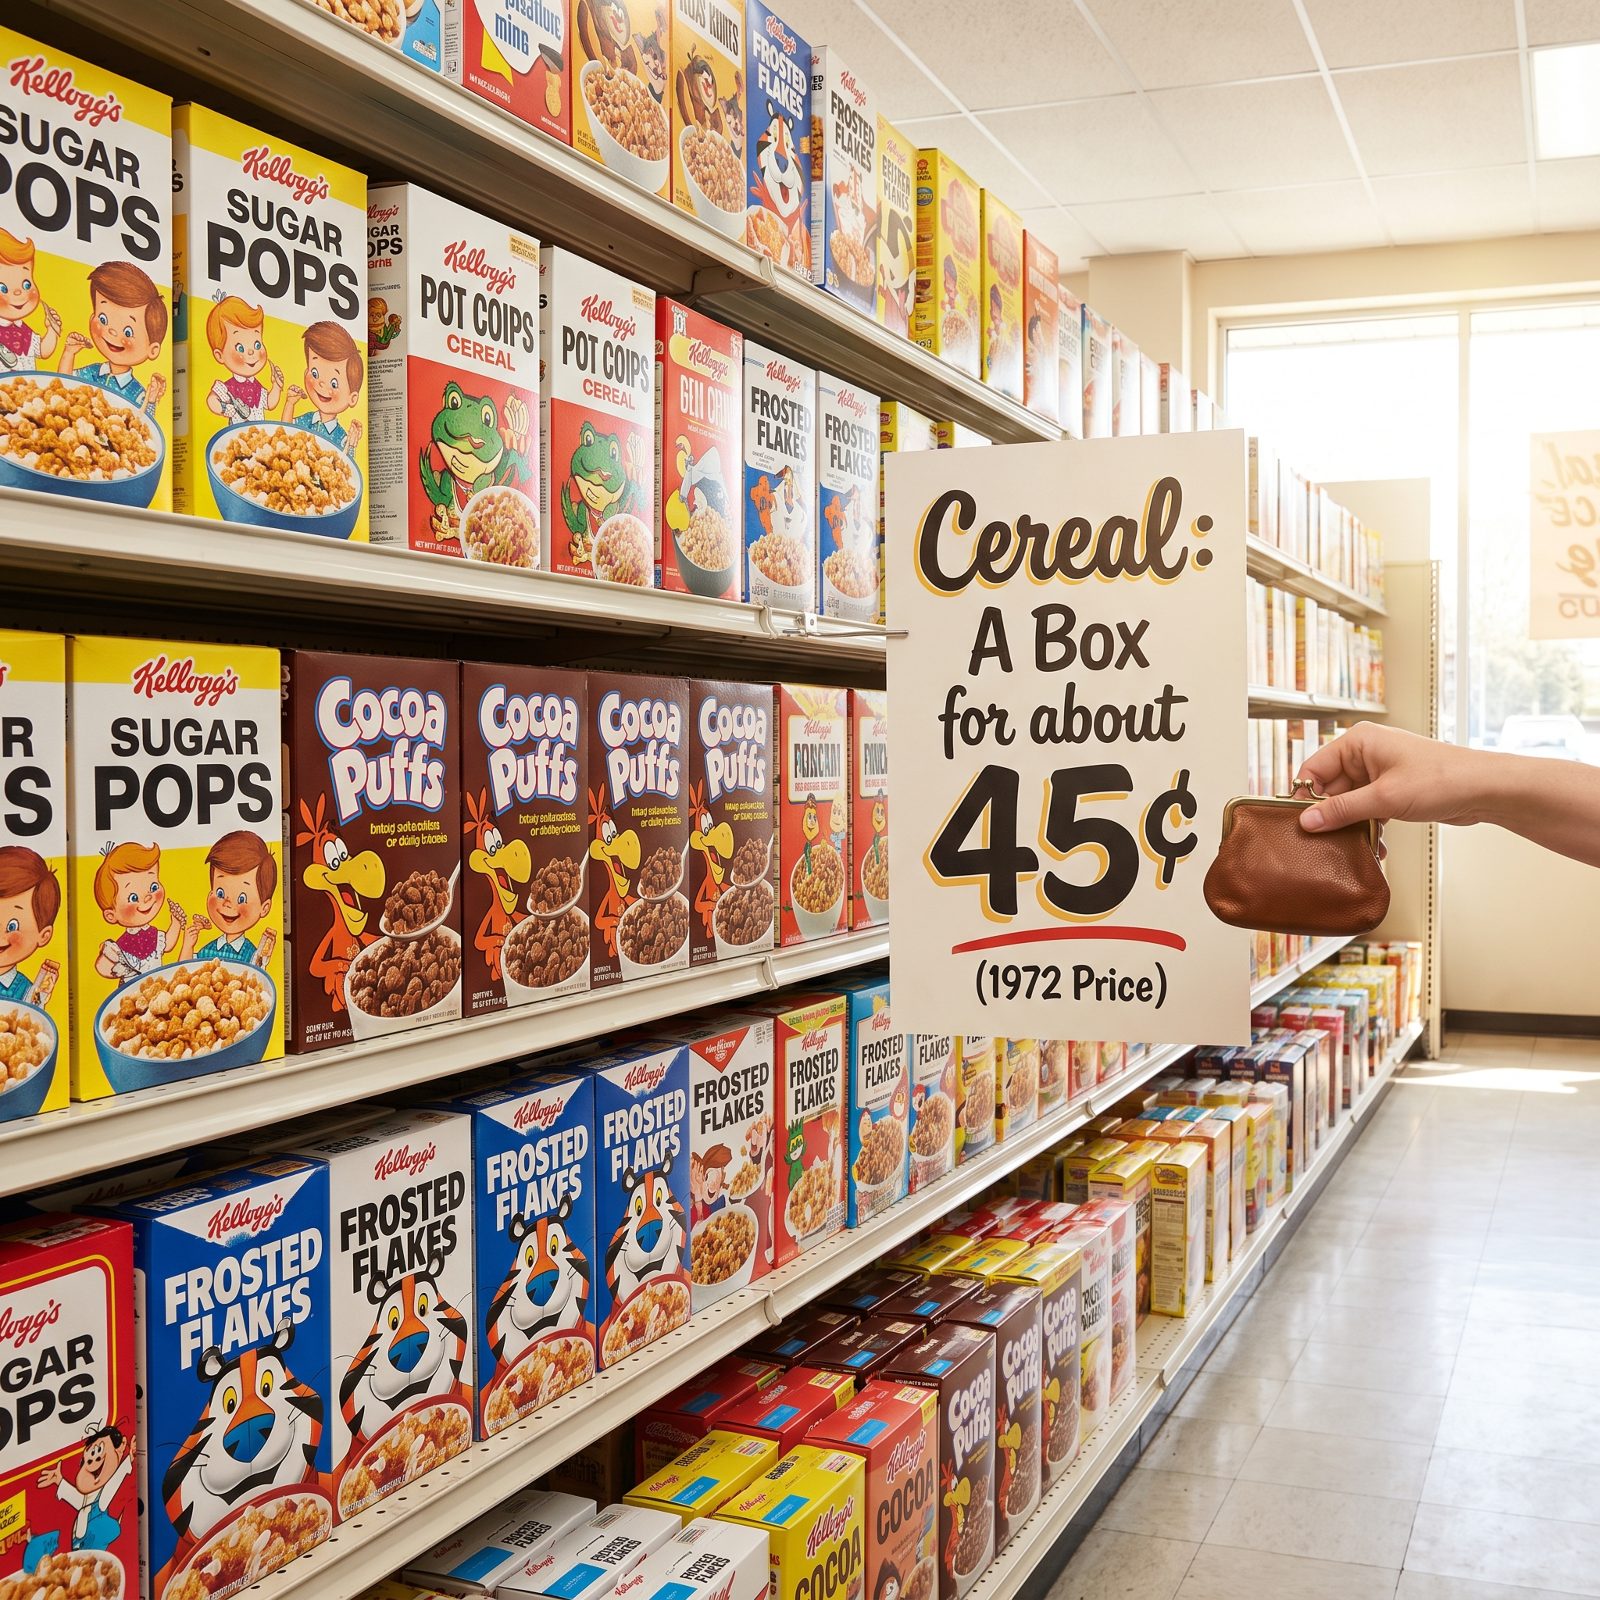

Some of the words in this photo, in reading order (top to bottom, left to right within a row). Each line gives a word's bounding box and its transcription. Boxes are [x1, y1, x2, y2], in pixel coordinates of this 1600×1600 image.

[11, 58, 122, 127] Kellogg's
[753, 29, 807, 98] FROSTED
[758, 68, 804, 121] FLAKES
[831, 89, 875, 150] FROSTED
[0, 103, 141, 189] SUGAR
[243, 147, 330, 205] Kellogg's
[835, 120, 872, 174] FLAKES
[0, 152, 161, 262] OPS
[227, 189, 342, 256] SUGAR
[207, 221, 360, 320] POPS
[368, 238, 403, 259] OPS
[443, 239, 517, 295] Kellogg's
[420, 273, 467, 330] POT
[472, 292, 535, 354] COIPS
[581, 294, 637, 341] Kellogg's
[446, 333, 516, 372] CEREAL
[562, 325, 599, 375] POT
[602, 340, 650, 394] COIPS
[582, 378, 636, 411] CEREAL
[751, 386, 812, 434] FROSTED
[757, 419, 807, 462] FLAKES
[825, 413, 877, 455] FROSTED
[830, 443, 873, 482] FLAKES
[914, 476, 1213, 597] Cereal:
[968, 606, 1013, 677] A
[1031, 603, 1150, 673] Box
[133, 656, 239, 707] Kellogg's
[111, 717, 259, 757] SUGAR
[315, 676, 447, 750] Cocoa
[479, 684, 578, 749] Cocoa
[598, 690, 682, 749] Cocoa
[698, 696, 767, 749] Cocoa
[938, 685, 1016, 759] for
[1030, 681, 1189, 745] about
[94, 762, 274, 831] POPS
[329, 738, 445, 825] Puffs
[488, 738, 577, 815] Puffs
[606, 740, 680, 809] Puffs
[704, 741, 766, 804] Puffs
[923, 764, 1198, 924] 45¢
[976, 960, 1062, 1006] (1972
[1073, 961, 1168, 1010] Price)
[624, 1061, 666, 1090] Kellogg's
[789, 1047, 839, 1089] FROSTED
[862, 1034, 904, 1066] FROSTED
[865, 1057, 901, 1089] FLAKES
[919, 1036, 950, 1066] FLAKES
[514, 1097, 564, 1130] Kellogg's
[694, 1062, 770, 1108] FROSTED
[701, 1091, 764, 1135] FLAKES
[794, 1075, 836, 1116] FLAKES
[604, 1088, 686, 1148] FROSTED
[374, 1141, 436, 1181] Kellogg's
[486, 1125, 588, 1194] FROSTED
[208, 1193, 284, 1241] Kellogg's
[340, 1170, 465, 1253] FROSTED
[496, 1164, 582, 1232] FLAKES
[165, 1227, 323, 1326] FROSTED
[352, 1215, 458, 1294] FLAKES
[180, 1276, 312, 1371] FLAKES
[1044, 1287, 1077, 1337] Cocoa
[0, 1334, 95, 1393] GAR
[1002, 1322, 1039, 1380] Cocoa
[949, 1368, 991, 1432] Cocoa
[1006, 1353, 1039, 1415] Puffs
[952, 1404, 991, 1468] Puffs
[806, 1495, 855, 1558] Kellogg's
[877, 1458, 935, 1546] COCOA
[795, 1525, 862, 1600] COCOA
